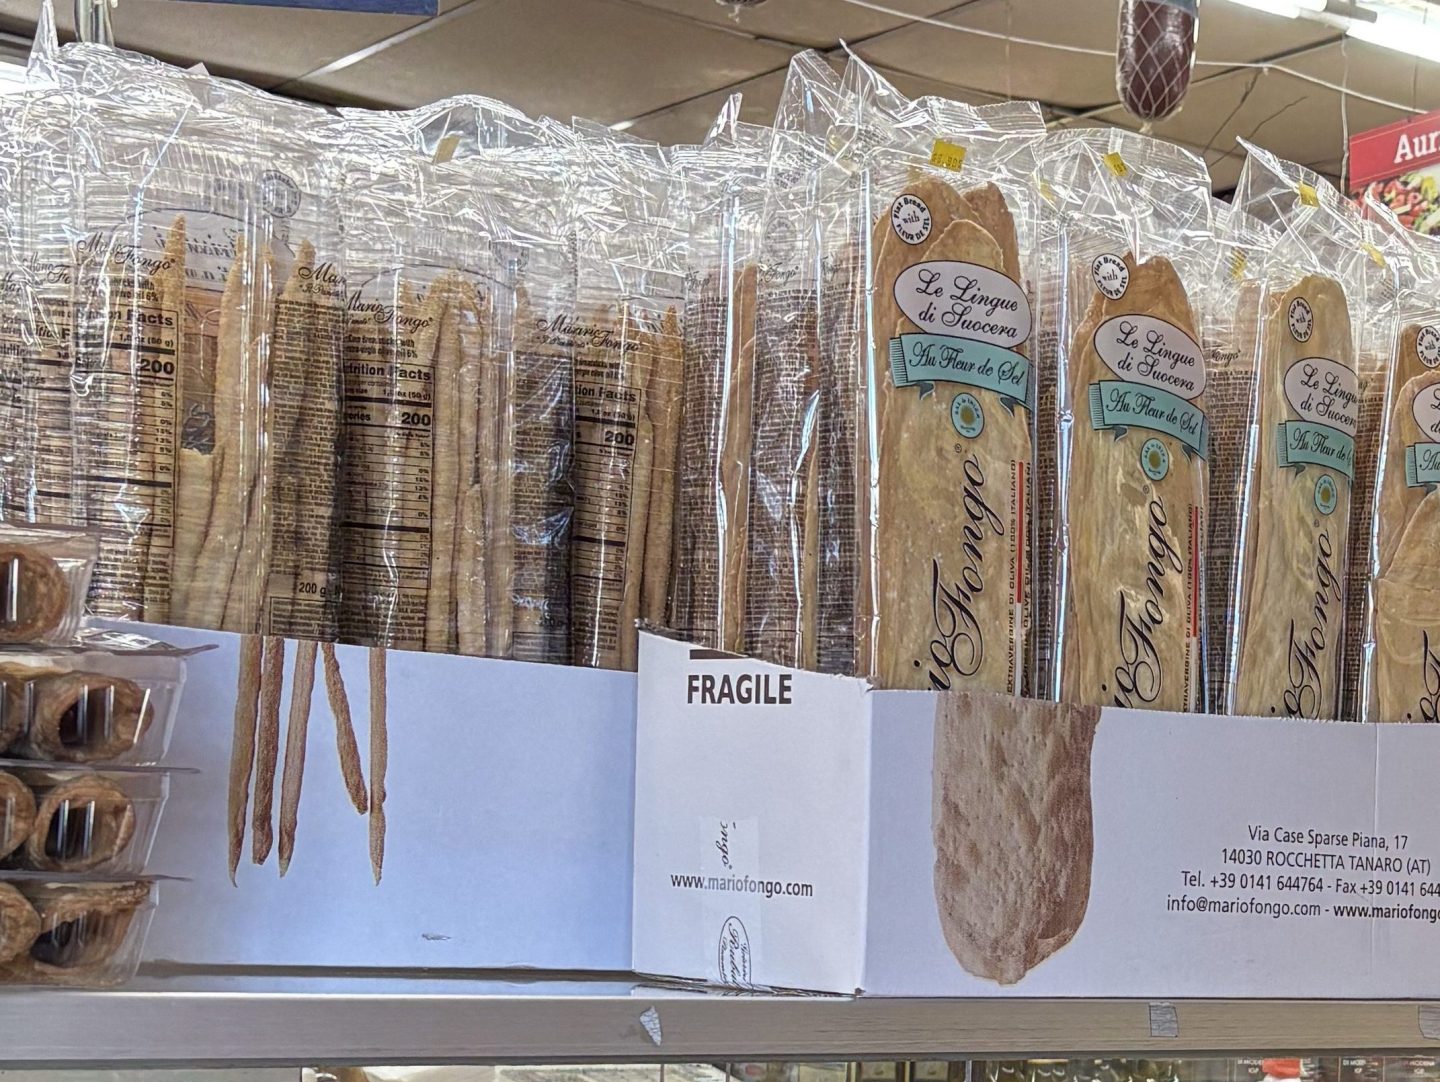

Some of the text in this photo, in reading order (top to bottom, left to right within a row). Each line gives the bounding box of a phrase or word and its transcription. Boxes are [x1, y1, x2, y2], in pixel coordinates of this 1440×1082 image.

[894, 197, 926, 219] Flat Bread
[902, 211, 920, 223] with
[1102, 270, 1118, 282] with
[1104, 256, 1126, 272] Bread
[916, 268, 1018, 317] Le Lingue
[374, 306, 432, 333] Fongo
[919, 302, 1018, 338] di Suocera
[1116, 321, 1196, 368] Le Lingue
[140, 359, 174, 375] 200
[909, 341, 1025, 386] Au Fleur de Sel
[1118, 356, 1195, 391] di Suocera
[1301, 364, 1320, 389] Le
[1106, 388, 1165, 422] Au Fleur
[1301, 394, 1313, 411] di
[402, 413, 431, 426] 200
[605, 431, 634, 445] 200
[1290, 429, 1335, 456] Au Fleur
[1419, 449, 1440, 471] Au
[933, 453, 1005, 677] Fongo
[299, 583, 326, 597] 200 g
[1120, 495, 1183, 703] Fongo
[1288, 529, 1341, 719] Fongo
[687, 674, 792, 705] FRAGILE
[1248, 825, 1408, 851] Via Case Sparse Piana, 17
[1222, 849, 1431, 876] 14030 ROCCHETTA TANARO (AT)
[671, 874, 813, 898] www.mariofongo.com
[1181, 871, 1205, 887] Tel.
[1210, 874, 1235, 889] +39
[1240, 875, 1272, 890] 0141
[1277, 876, 1323, 892] 644764
[1335, 880, 1356, 894] Fax
[1360, 881, 1382, 896] +39
[1386, 881, 1415, 897] 0141
[1167, 896, 1320, 918] info@mariofongo.com
